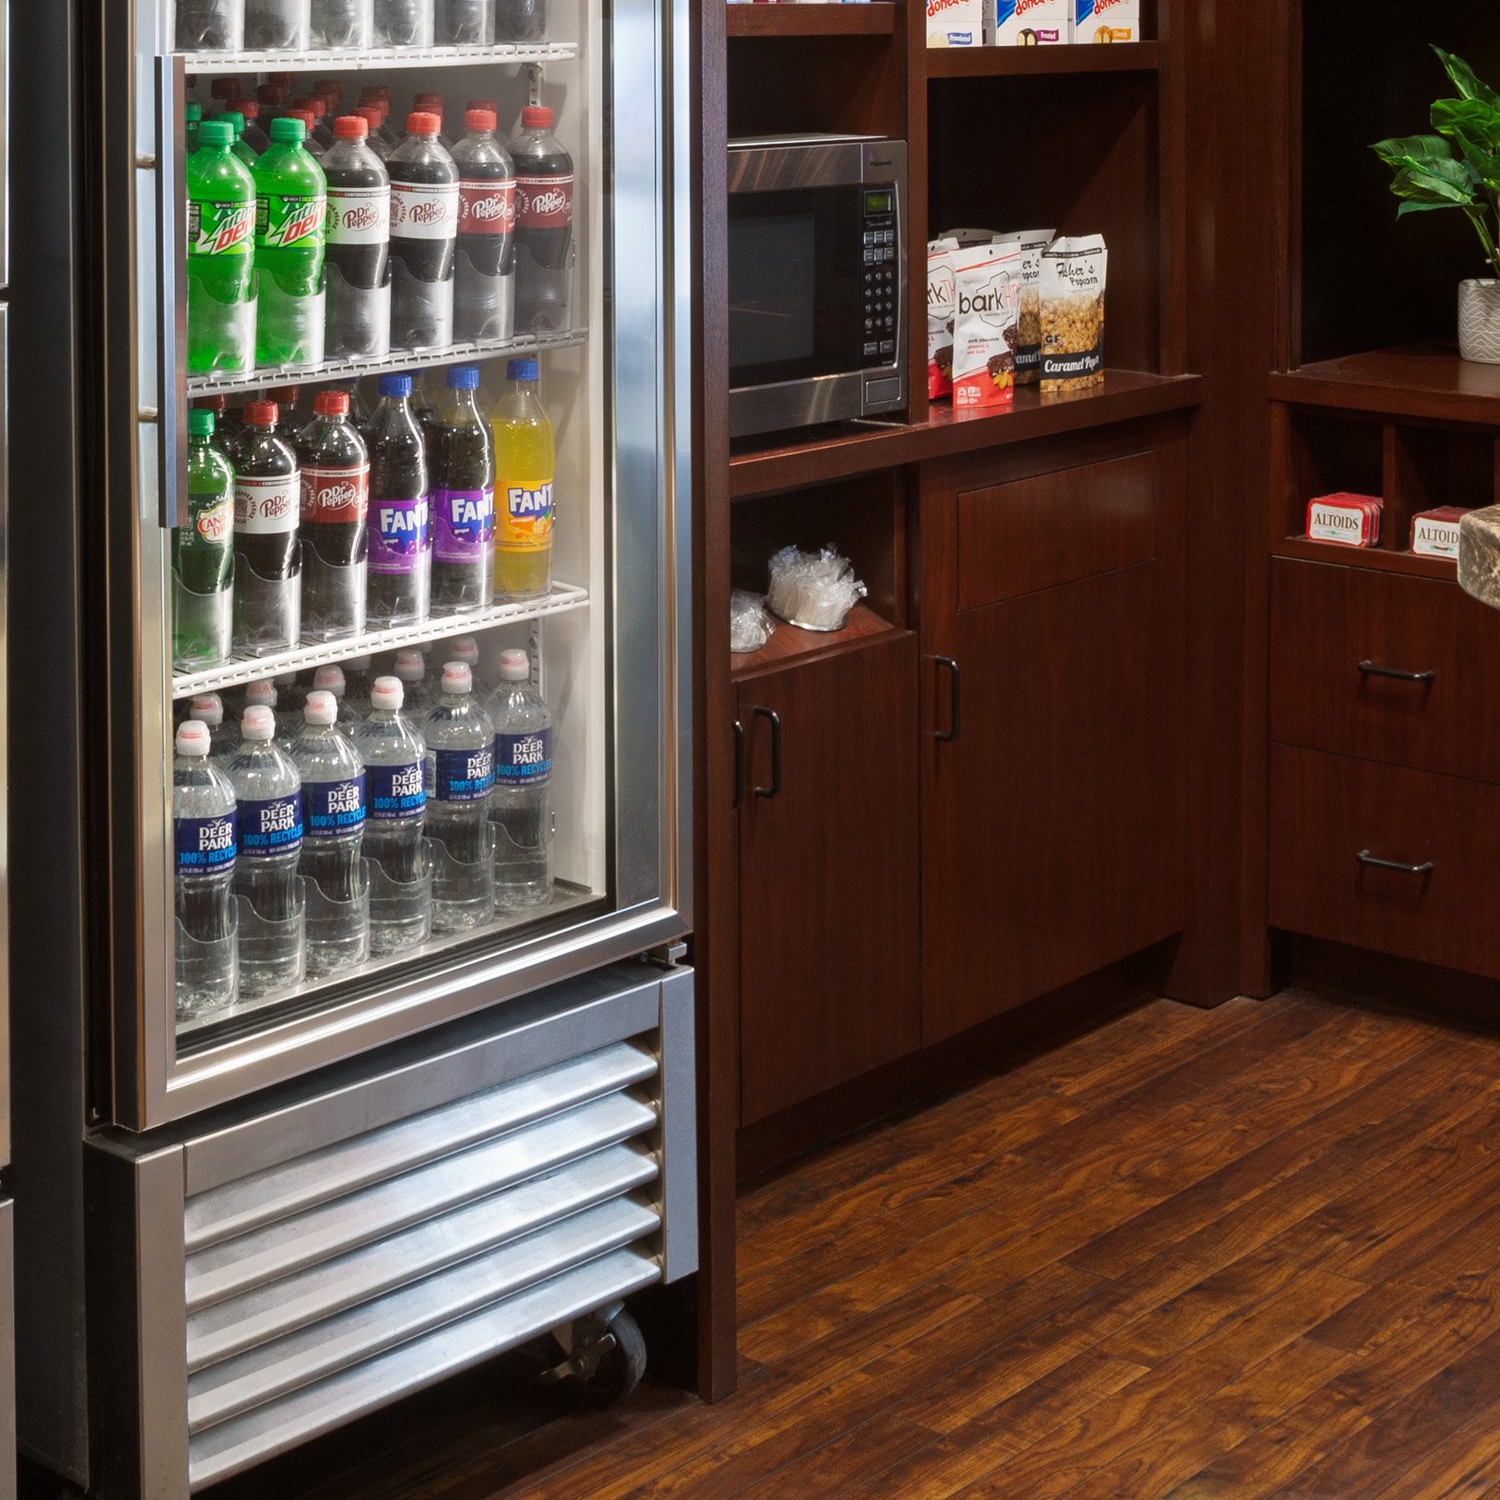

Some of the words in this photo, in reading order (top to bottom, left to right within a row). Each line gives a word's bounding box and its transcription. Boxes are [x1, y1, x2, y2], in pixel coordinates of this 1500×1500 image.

[485, 196, 497, 206] Dr
[545, 192, 557, 201] Dr
[424, 201, 437, 211] Dr
[472, 199, 506, 219] Pepper
[532, 194, 564, 214] Pepper
[342, 209, 377, 229] Pepper
[356, 207, 368, 217] Dr
[409, 204, 444, 223] Pepper
[1069, 276, 1098, 287] Popcorn
[1045, 335, 1060, 343] GF
[1044, 359, 1083, 373] Caramel
[333, 485, 345, 495] Dr
[274, 495, 286, 505] Dr
[318, 488, 354, 509] Pepper
[1314, 512, 1359, 530] ALTOIDS
[1418, 527, 1459, 544] ALTOID
[513, 741, 543, 753] DEER
[467, 754, 491, 769] DEER
[513, 752, 543, 764] PARK
[467, 766, 491, 779] PARK
[497, 763, 519, 775] 100%
[392, 768, 422, 786] DEER
[328, 786, 359, 803] DEER
[392, 782, 423, 797] PARK
[260, 804, 294, 823] DEER
[328, 799, 360, 814] PARK
[199, 822, 232, 841] DEER
[261, 817, 295, 833] PARK
[199, 836, 233, 850] PARK
[179, 852, 206, 864] 100%
